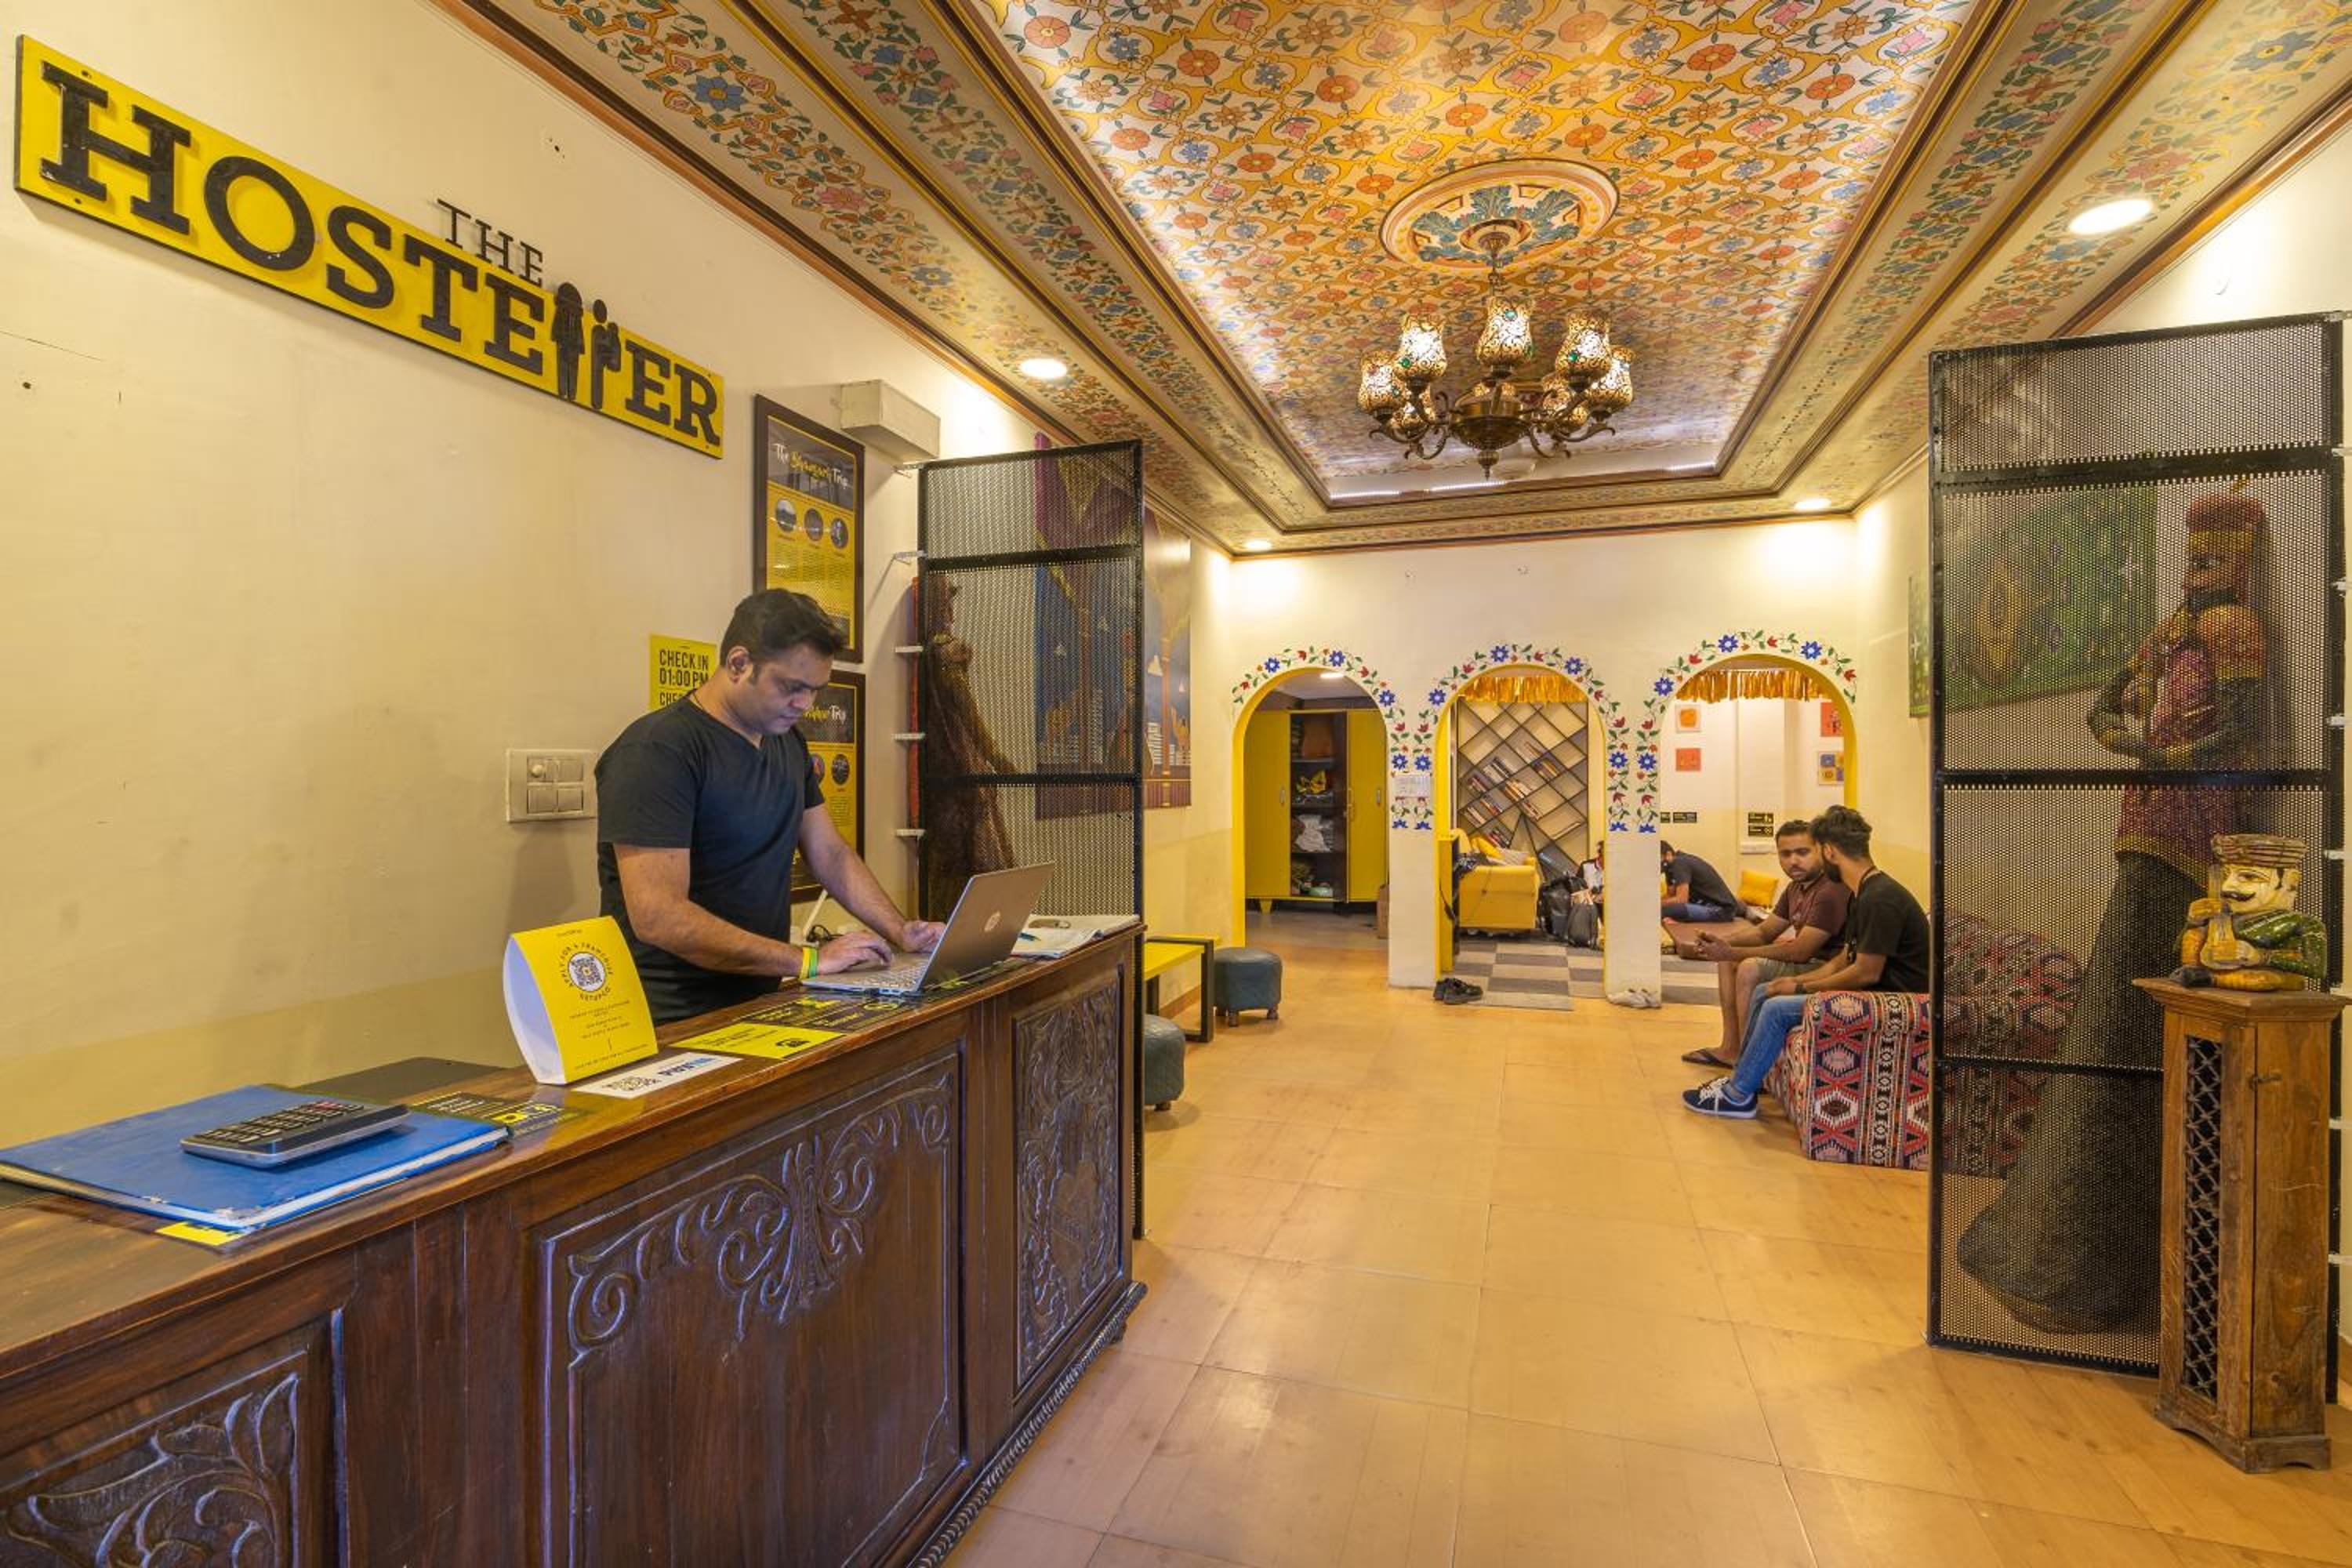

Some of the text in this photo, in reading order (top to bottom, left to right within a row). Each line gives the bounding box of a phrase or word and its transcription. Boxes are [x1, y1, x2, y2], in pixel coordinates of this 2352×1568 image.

[41, 60, 720, 447] HOSTEER
[437, 198, 543, 287] THE
[659, 649, 709, 672] CHECK IN
[659, 668, 709, 688] 01:00 PM
[659, 692, 683, 706] CHE
